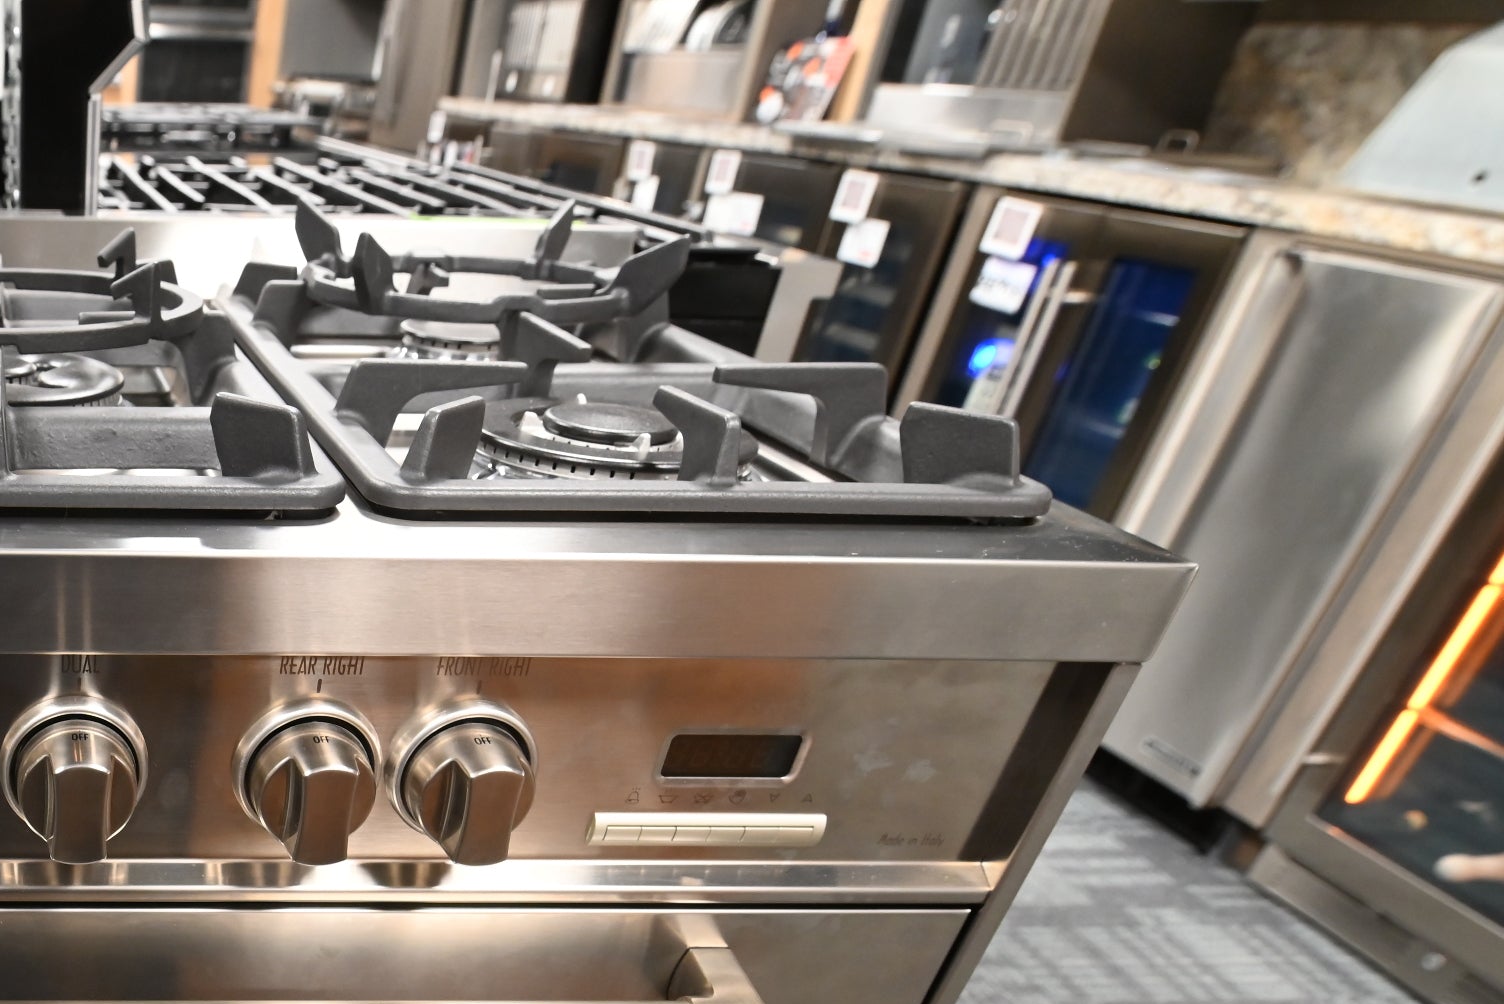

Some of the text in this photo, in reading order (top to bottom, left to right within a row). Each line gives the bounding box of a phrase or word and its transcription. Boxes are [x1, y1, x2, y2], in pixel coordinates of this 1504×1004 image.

[60, 654, 101, 674] DUAL
[279, 655, 366, 675] REAR RIGHT
[436, 656, 533, 677] FRONT RIGHT
[71, 733, 89, 741] OFF
[312, 735, 330, 744] OFF
[473, 737, 493, 745] OFF
